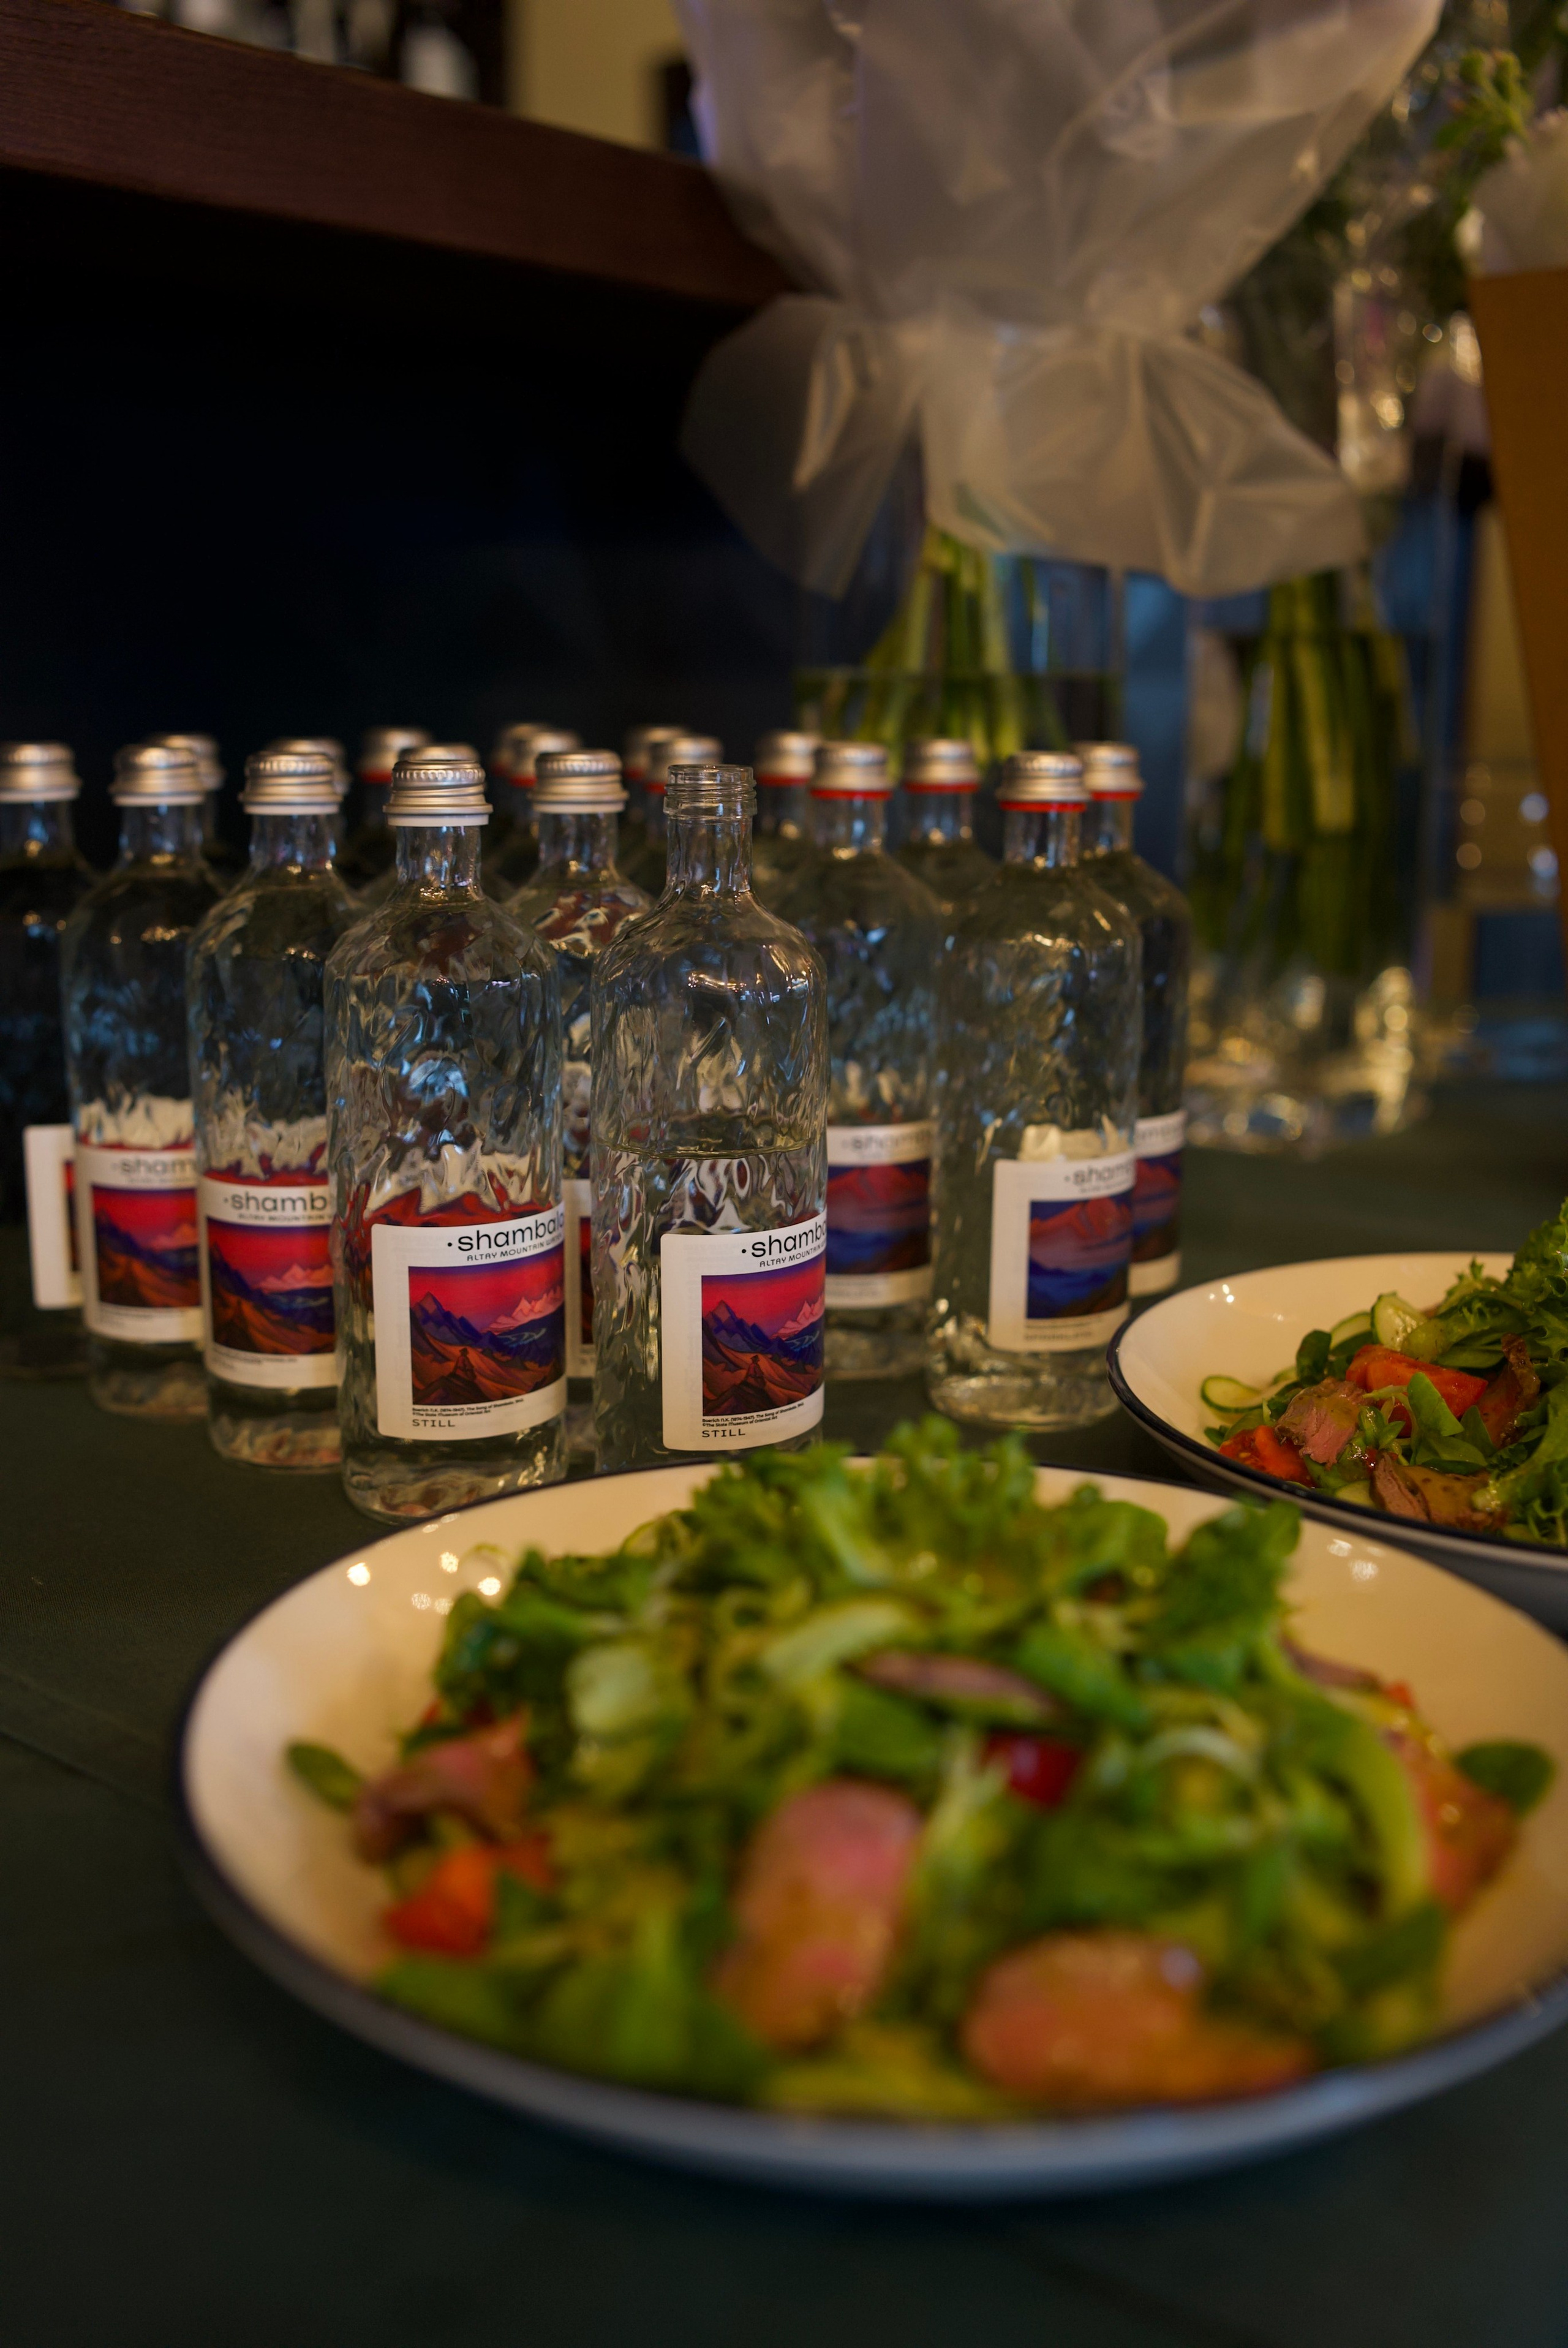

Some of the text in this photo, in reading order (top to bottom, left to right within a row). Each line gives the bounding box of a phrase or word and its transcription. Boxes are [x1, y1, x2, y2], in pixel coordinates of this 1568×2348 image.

[467, 1252, 497, 1261] ALTAY
[500, 1241, 545, 1258] MOUNTAIN
[760, 1257, 786, 1267] ALTAY
[788, 1245, 821, 1262] MOUNTAIN
[412, 1419, 456, 1427] STILL
[702, 1428, 746, 1438] STILL
